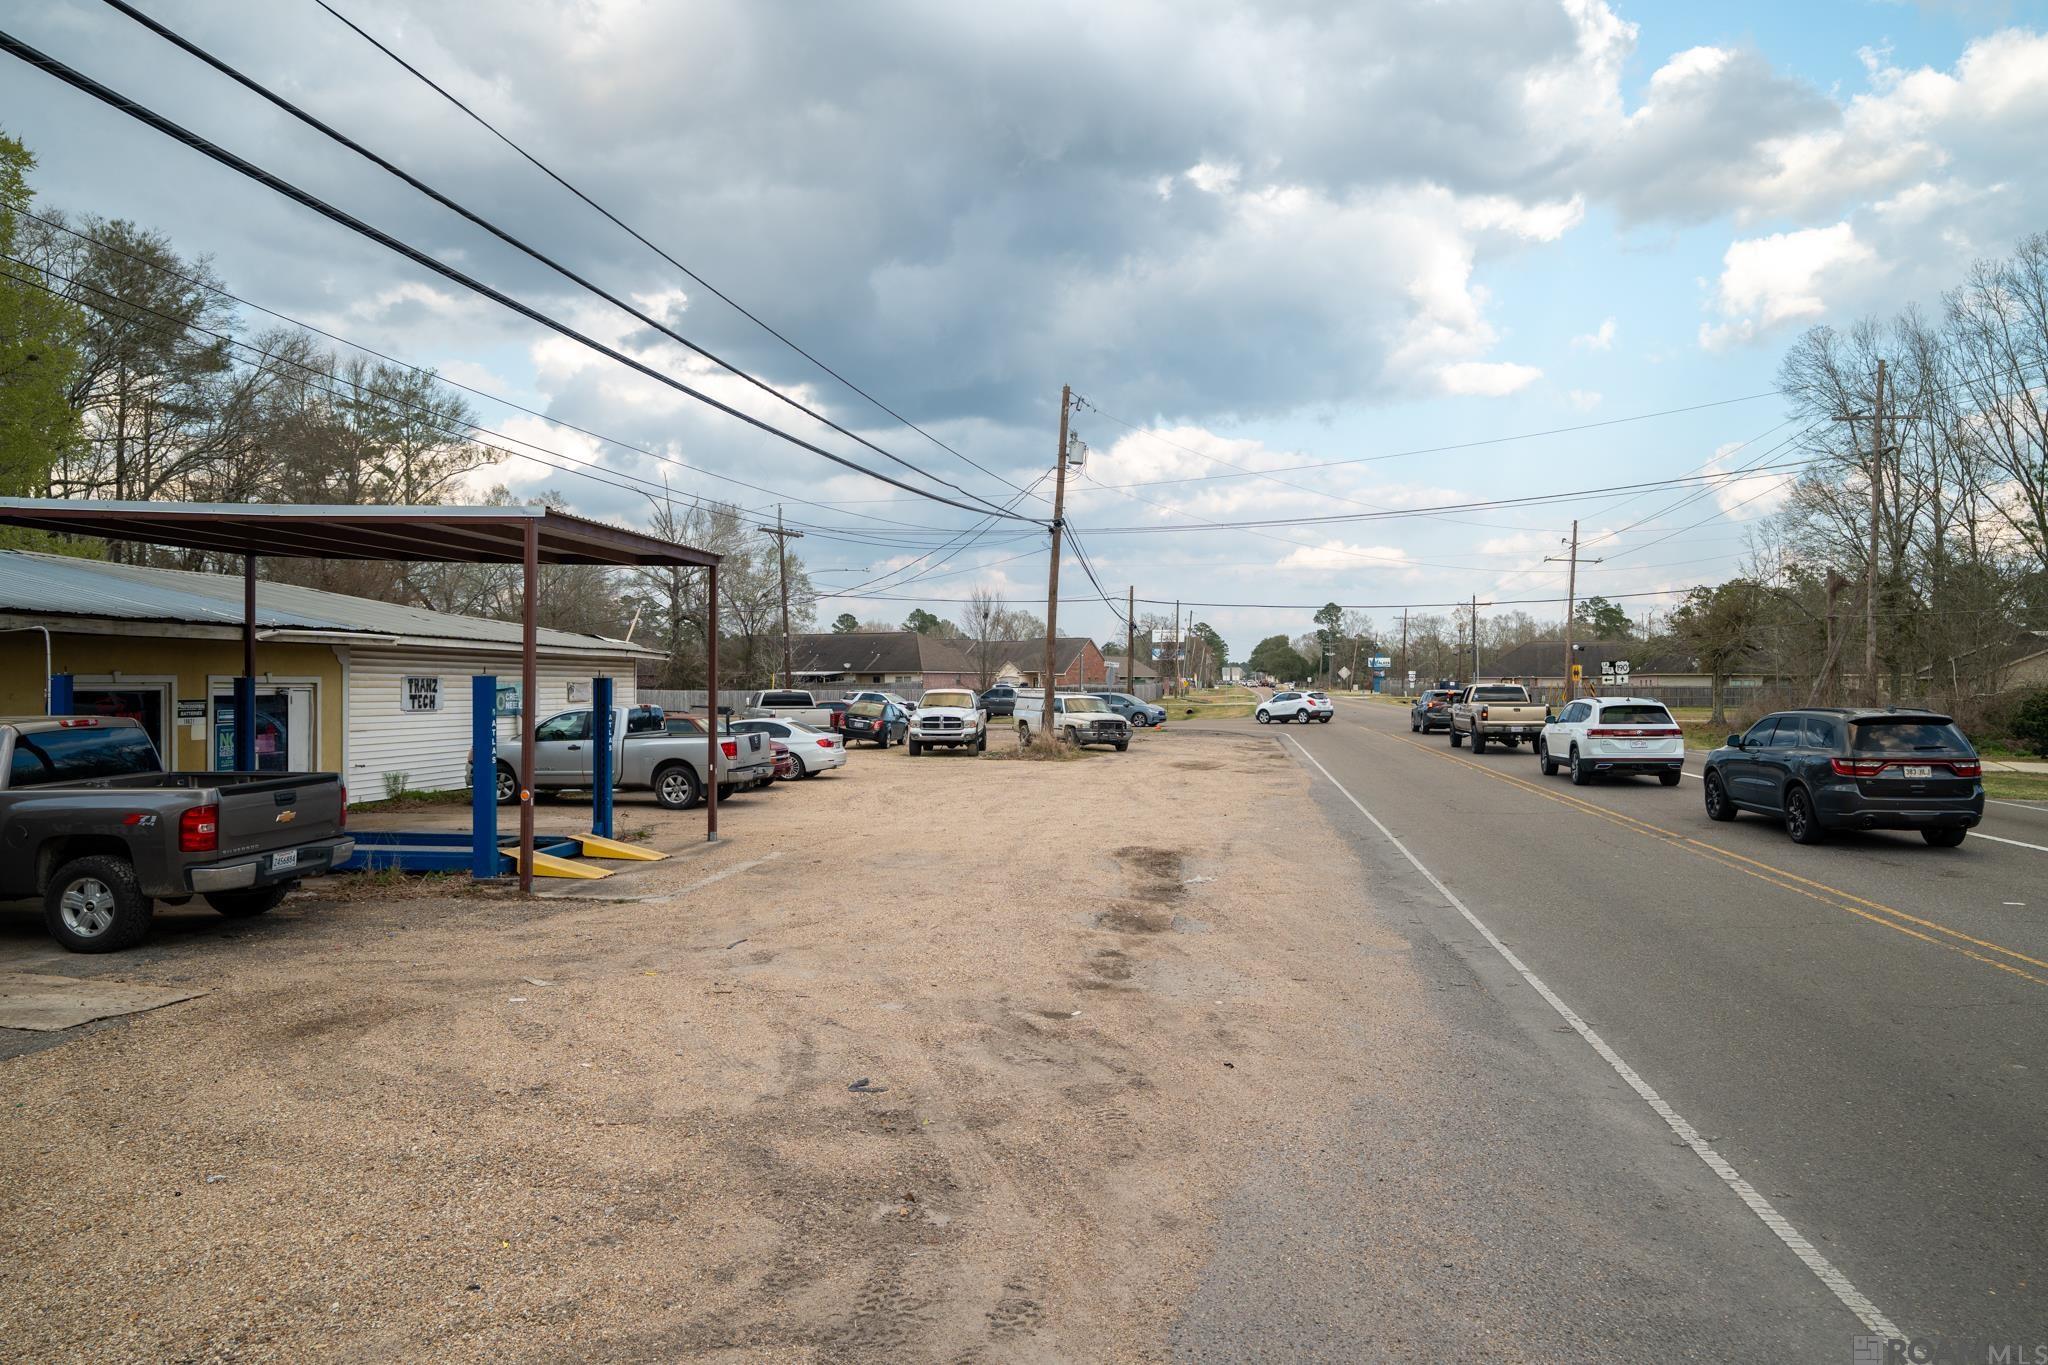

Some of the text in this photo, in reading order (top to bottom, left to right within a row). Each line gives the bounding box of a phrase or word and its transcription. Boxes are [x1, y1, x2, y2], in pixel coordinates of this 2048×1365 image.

[1616, 663, 1628, 672] 190
[407, 678, 438, 693] TRANZ
[409, 694, 436, 709] TECH
